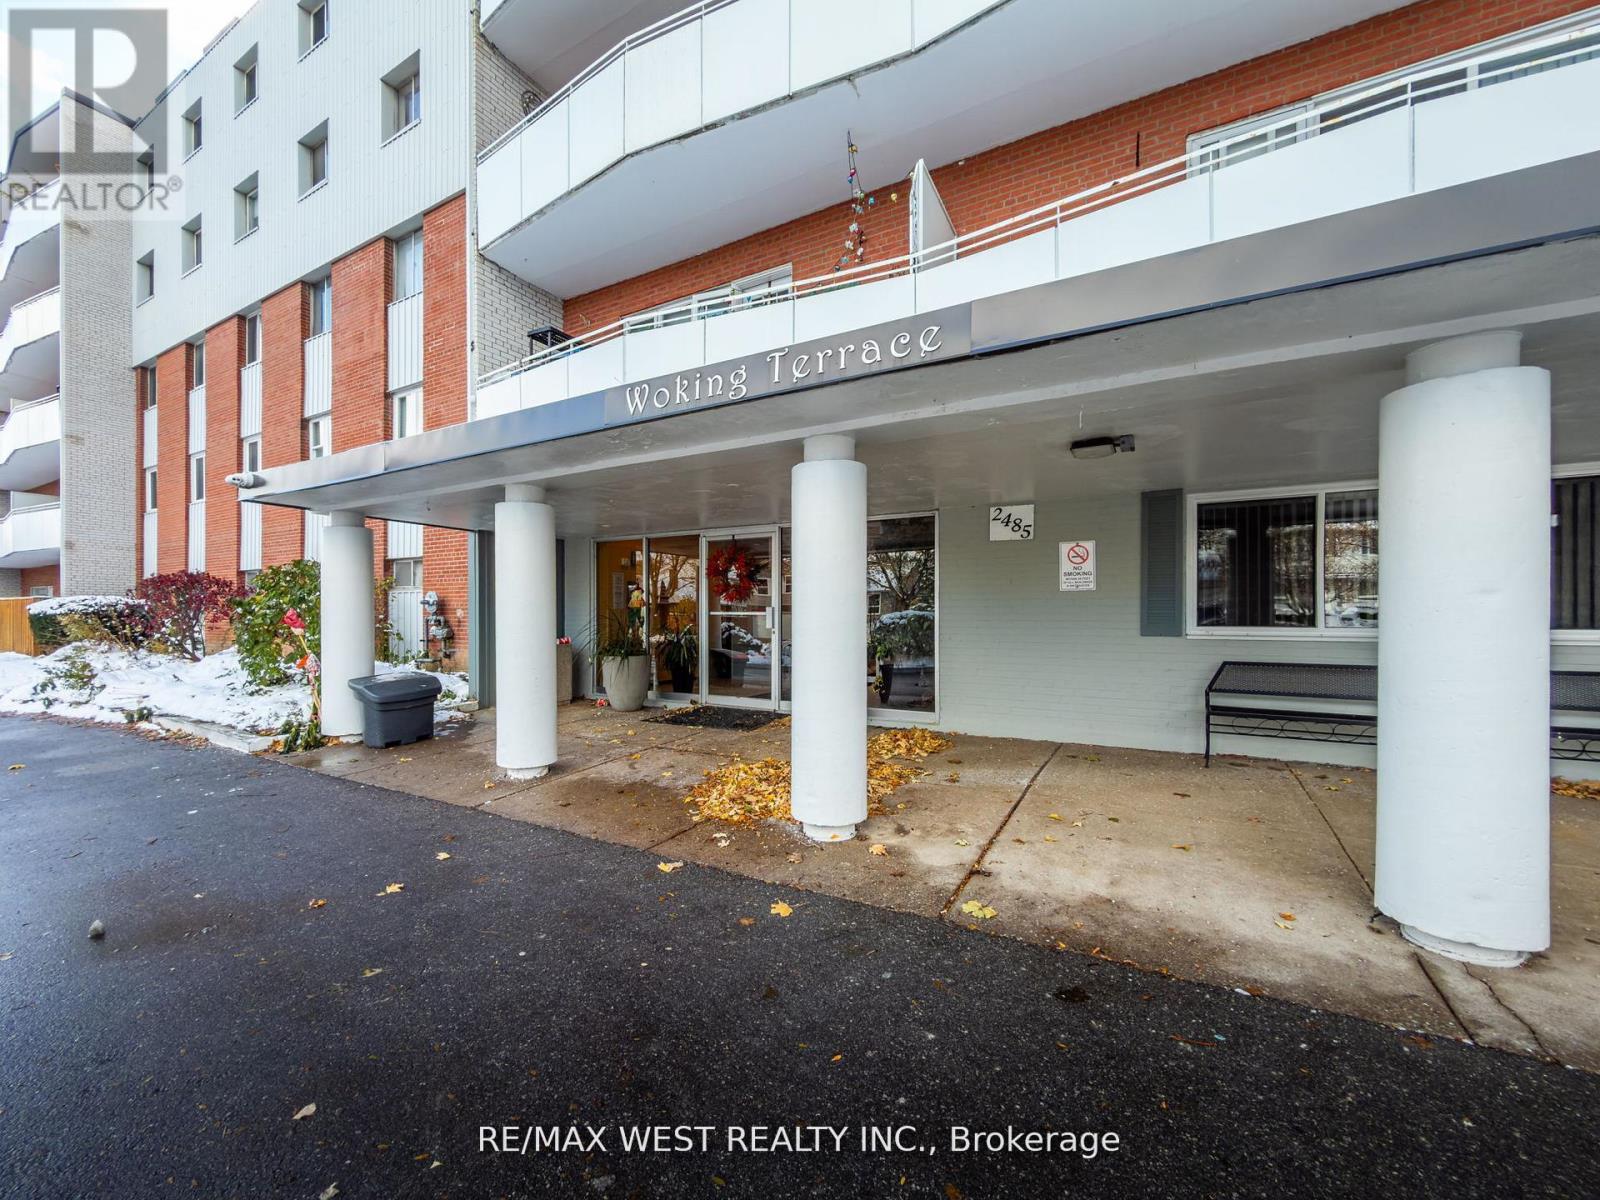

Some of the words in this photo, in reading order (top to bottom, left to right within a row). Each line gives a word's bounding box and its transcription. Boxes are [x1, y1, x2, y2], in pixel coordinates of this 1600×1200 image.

[625, 364, 748, 416] Woking
[766, 325, 943, 384] Terrace
[991, 507, 1032, 539] 2485
